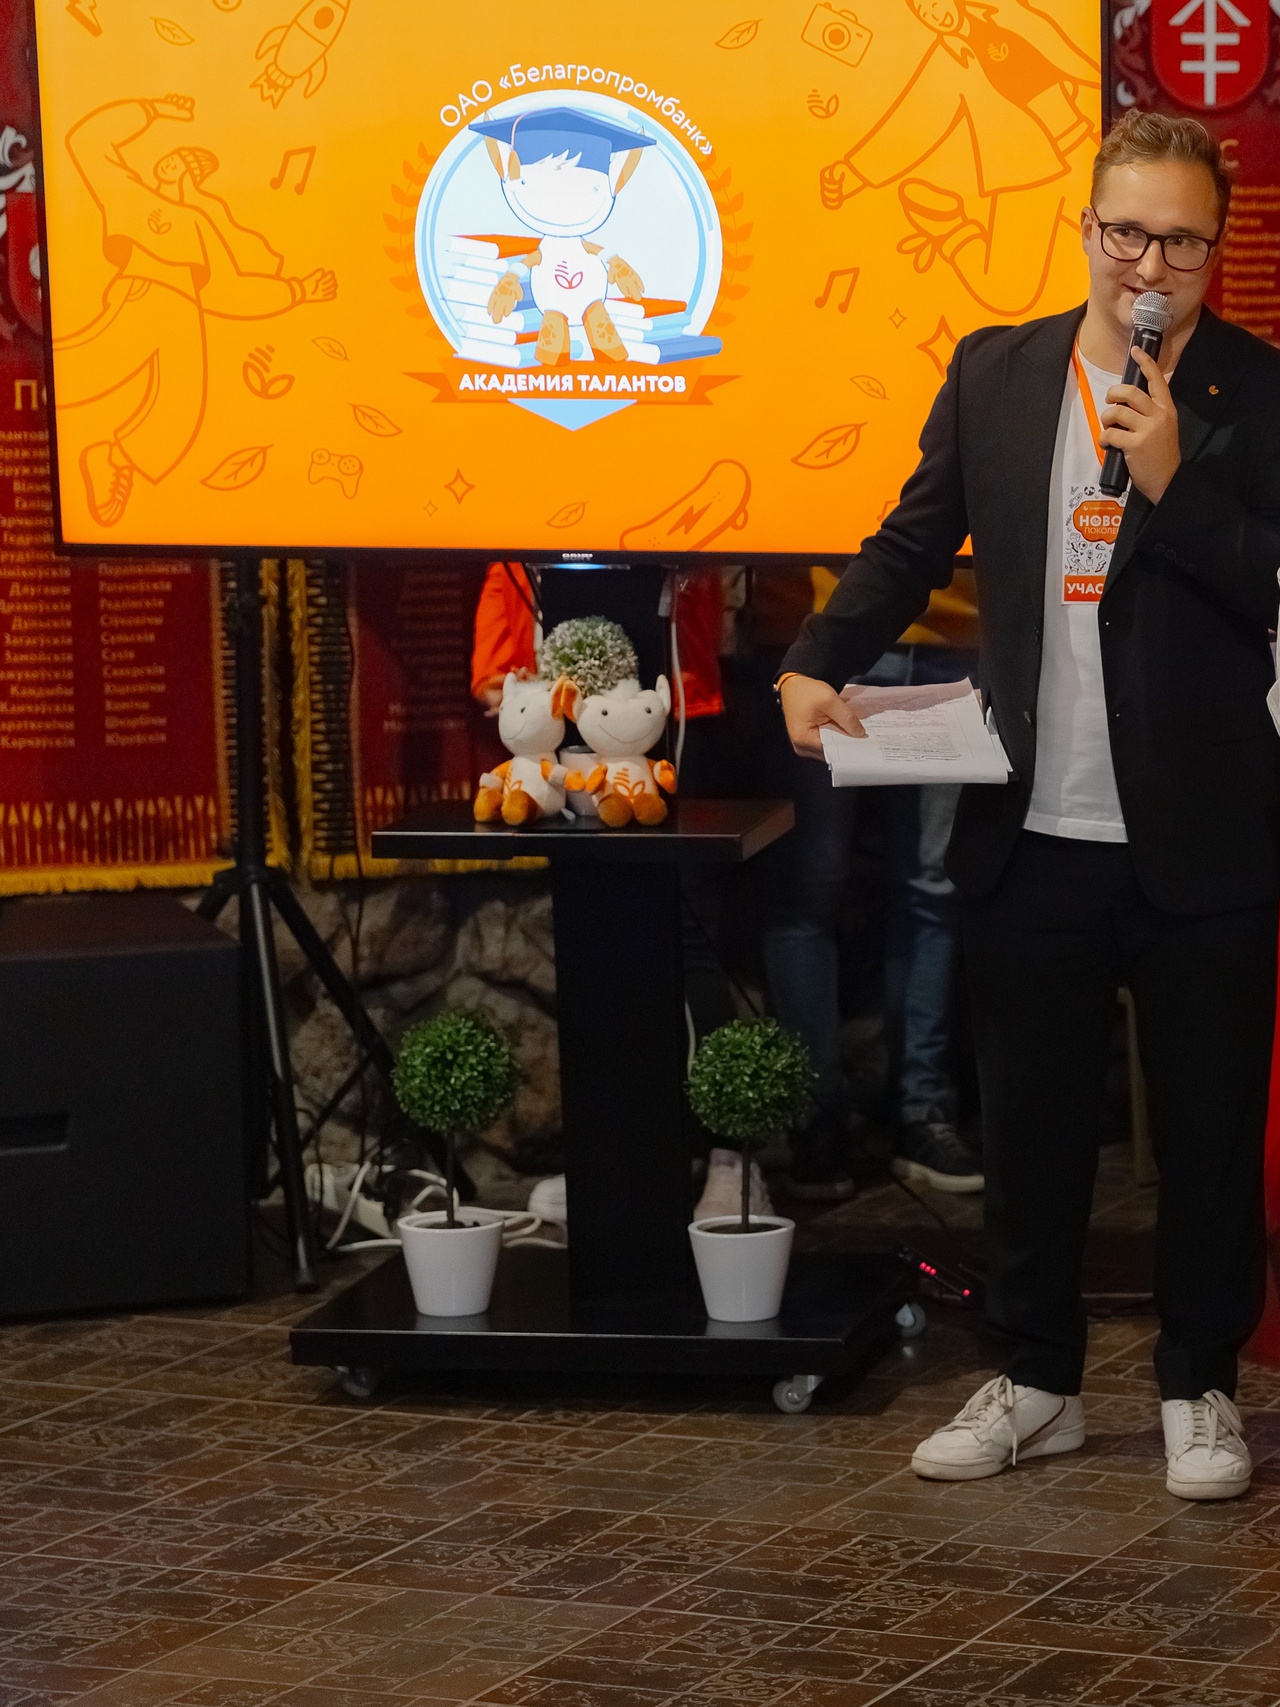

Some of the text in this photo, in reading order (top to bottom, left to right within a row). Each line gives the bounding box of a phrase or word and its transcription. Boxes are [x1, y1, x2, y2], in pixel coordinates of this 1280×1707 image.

[439, 63, 713, 157] ОАО «Белагропромбанк»
[458, 373, 687, 393] АКАДЕМИЯ ТАЛАНТОВ
[1066, 583, 1104, 594] УЧАС
